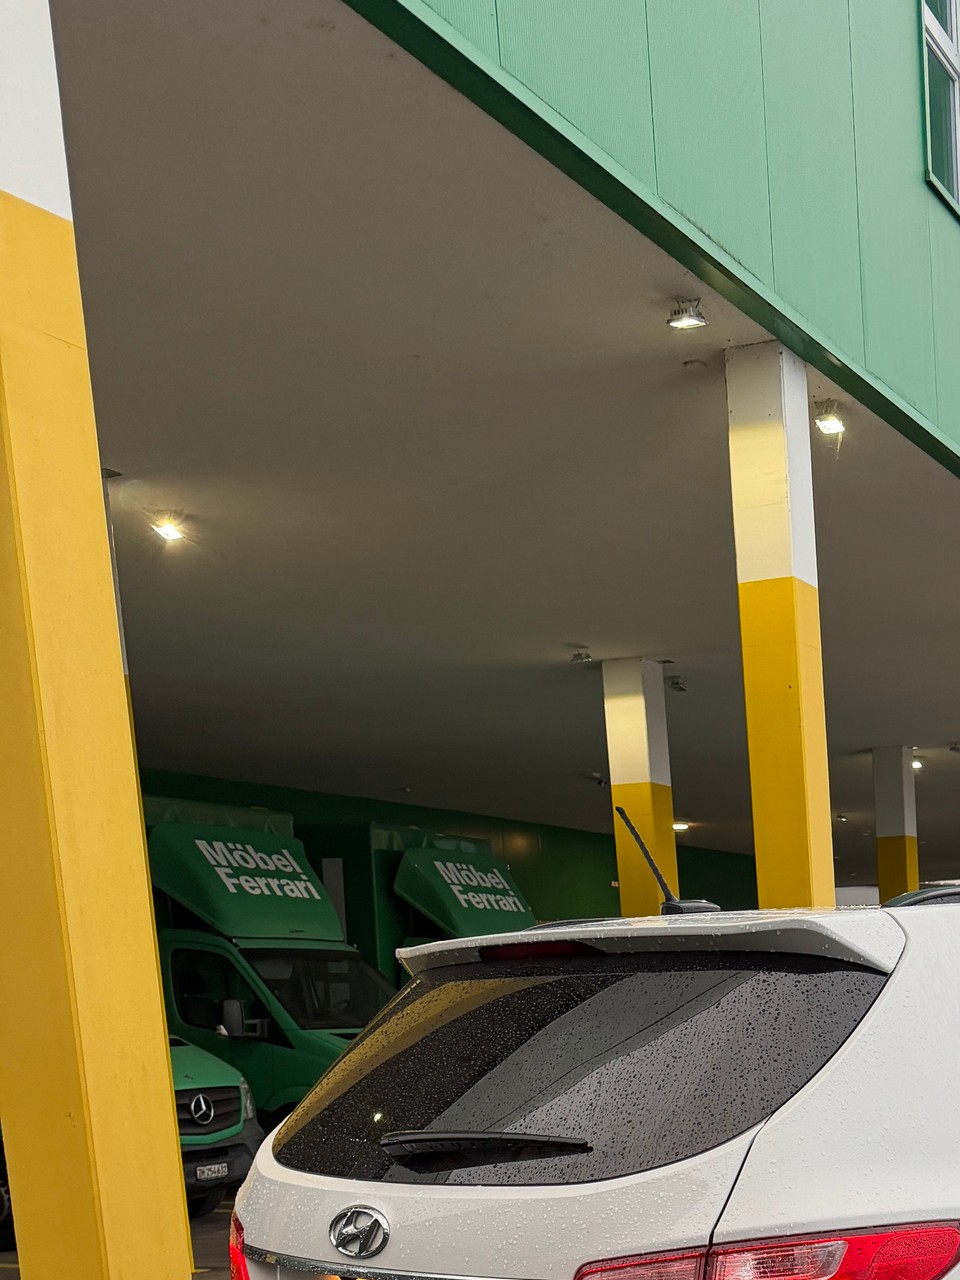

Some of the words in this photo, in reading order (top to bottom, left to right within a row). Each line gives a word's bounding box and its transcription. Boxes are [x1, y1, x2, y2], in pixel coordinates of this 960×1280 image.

[195, 839, 303, 873] Möbel
[214, 866, 321, 899] Ferrari
[433, 861, 510, 889] Möbel
[450, 885, 525, 912] Ferrari
